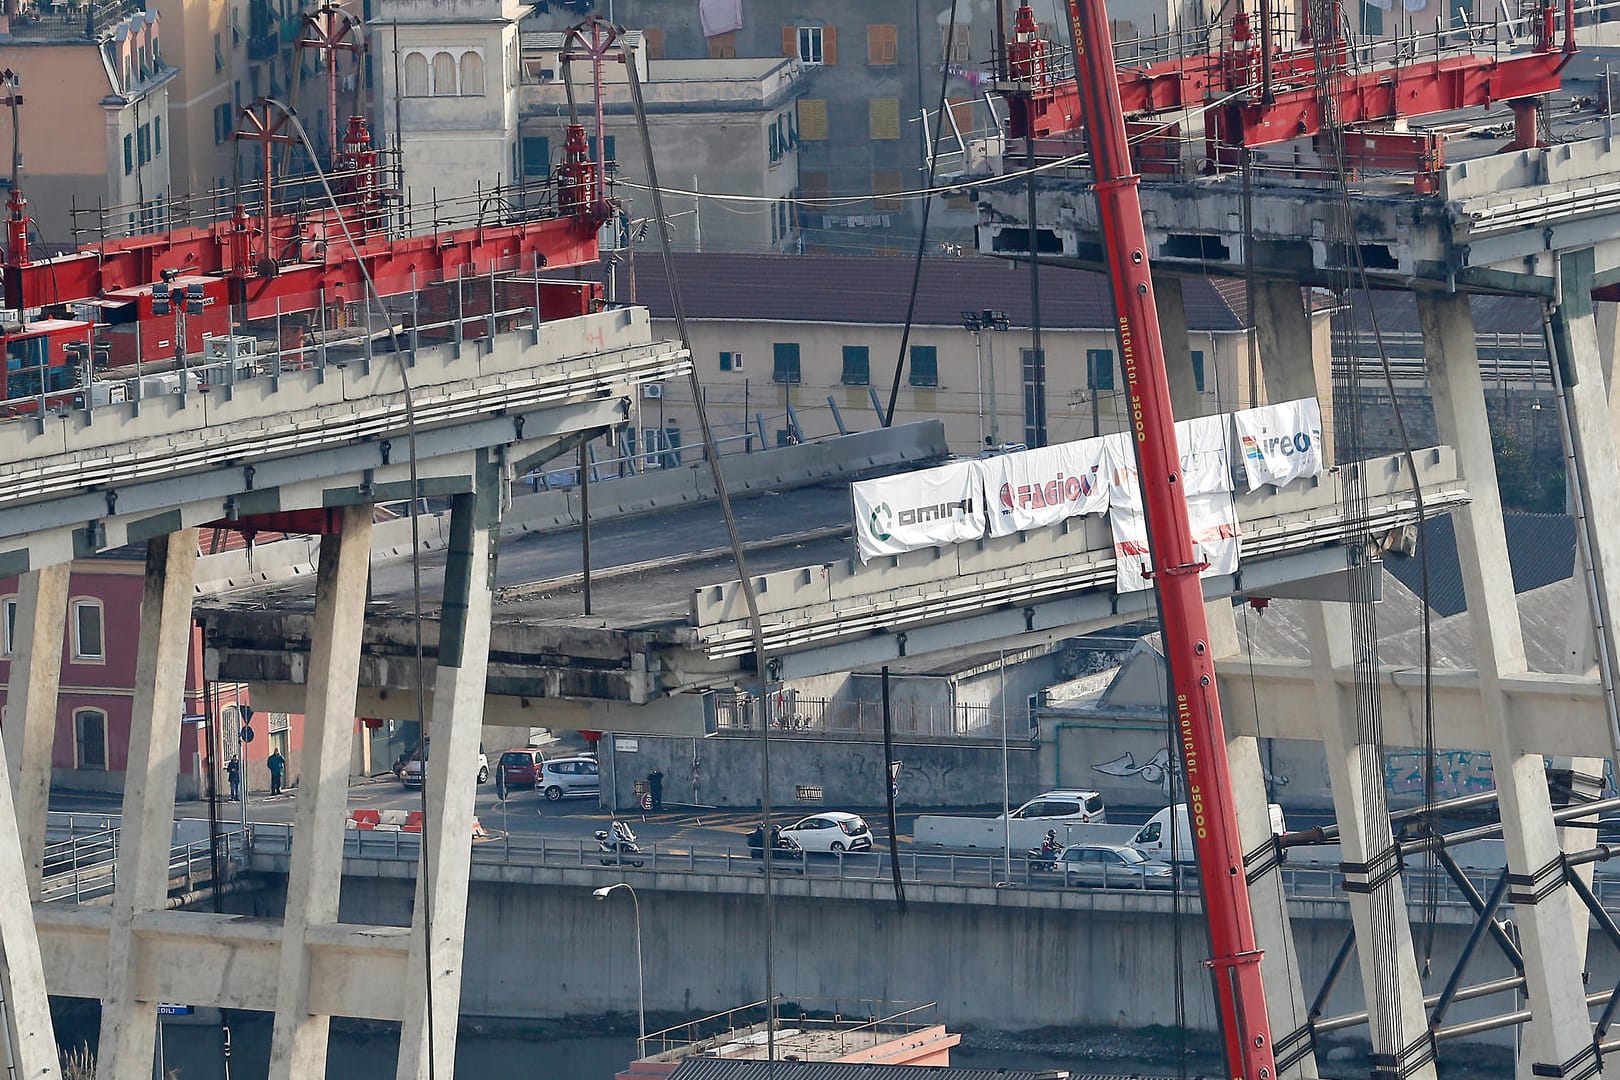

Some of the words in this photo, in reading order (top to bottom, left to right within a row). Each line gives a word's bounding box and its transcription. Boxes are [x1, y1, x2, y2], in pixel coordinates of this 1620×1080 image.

[1119, 317, 1138, 385] autovictor
[1132, 395, 1146, 442] 35000
[1177, 694, 1198, 774] autovictor
[1191, 785, 1207, 839] 35000
